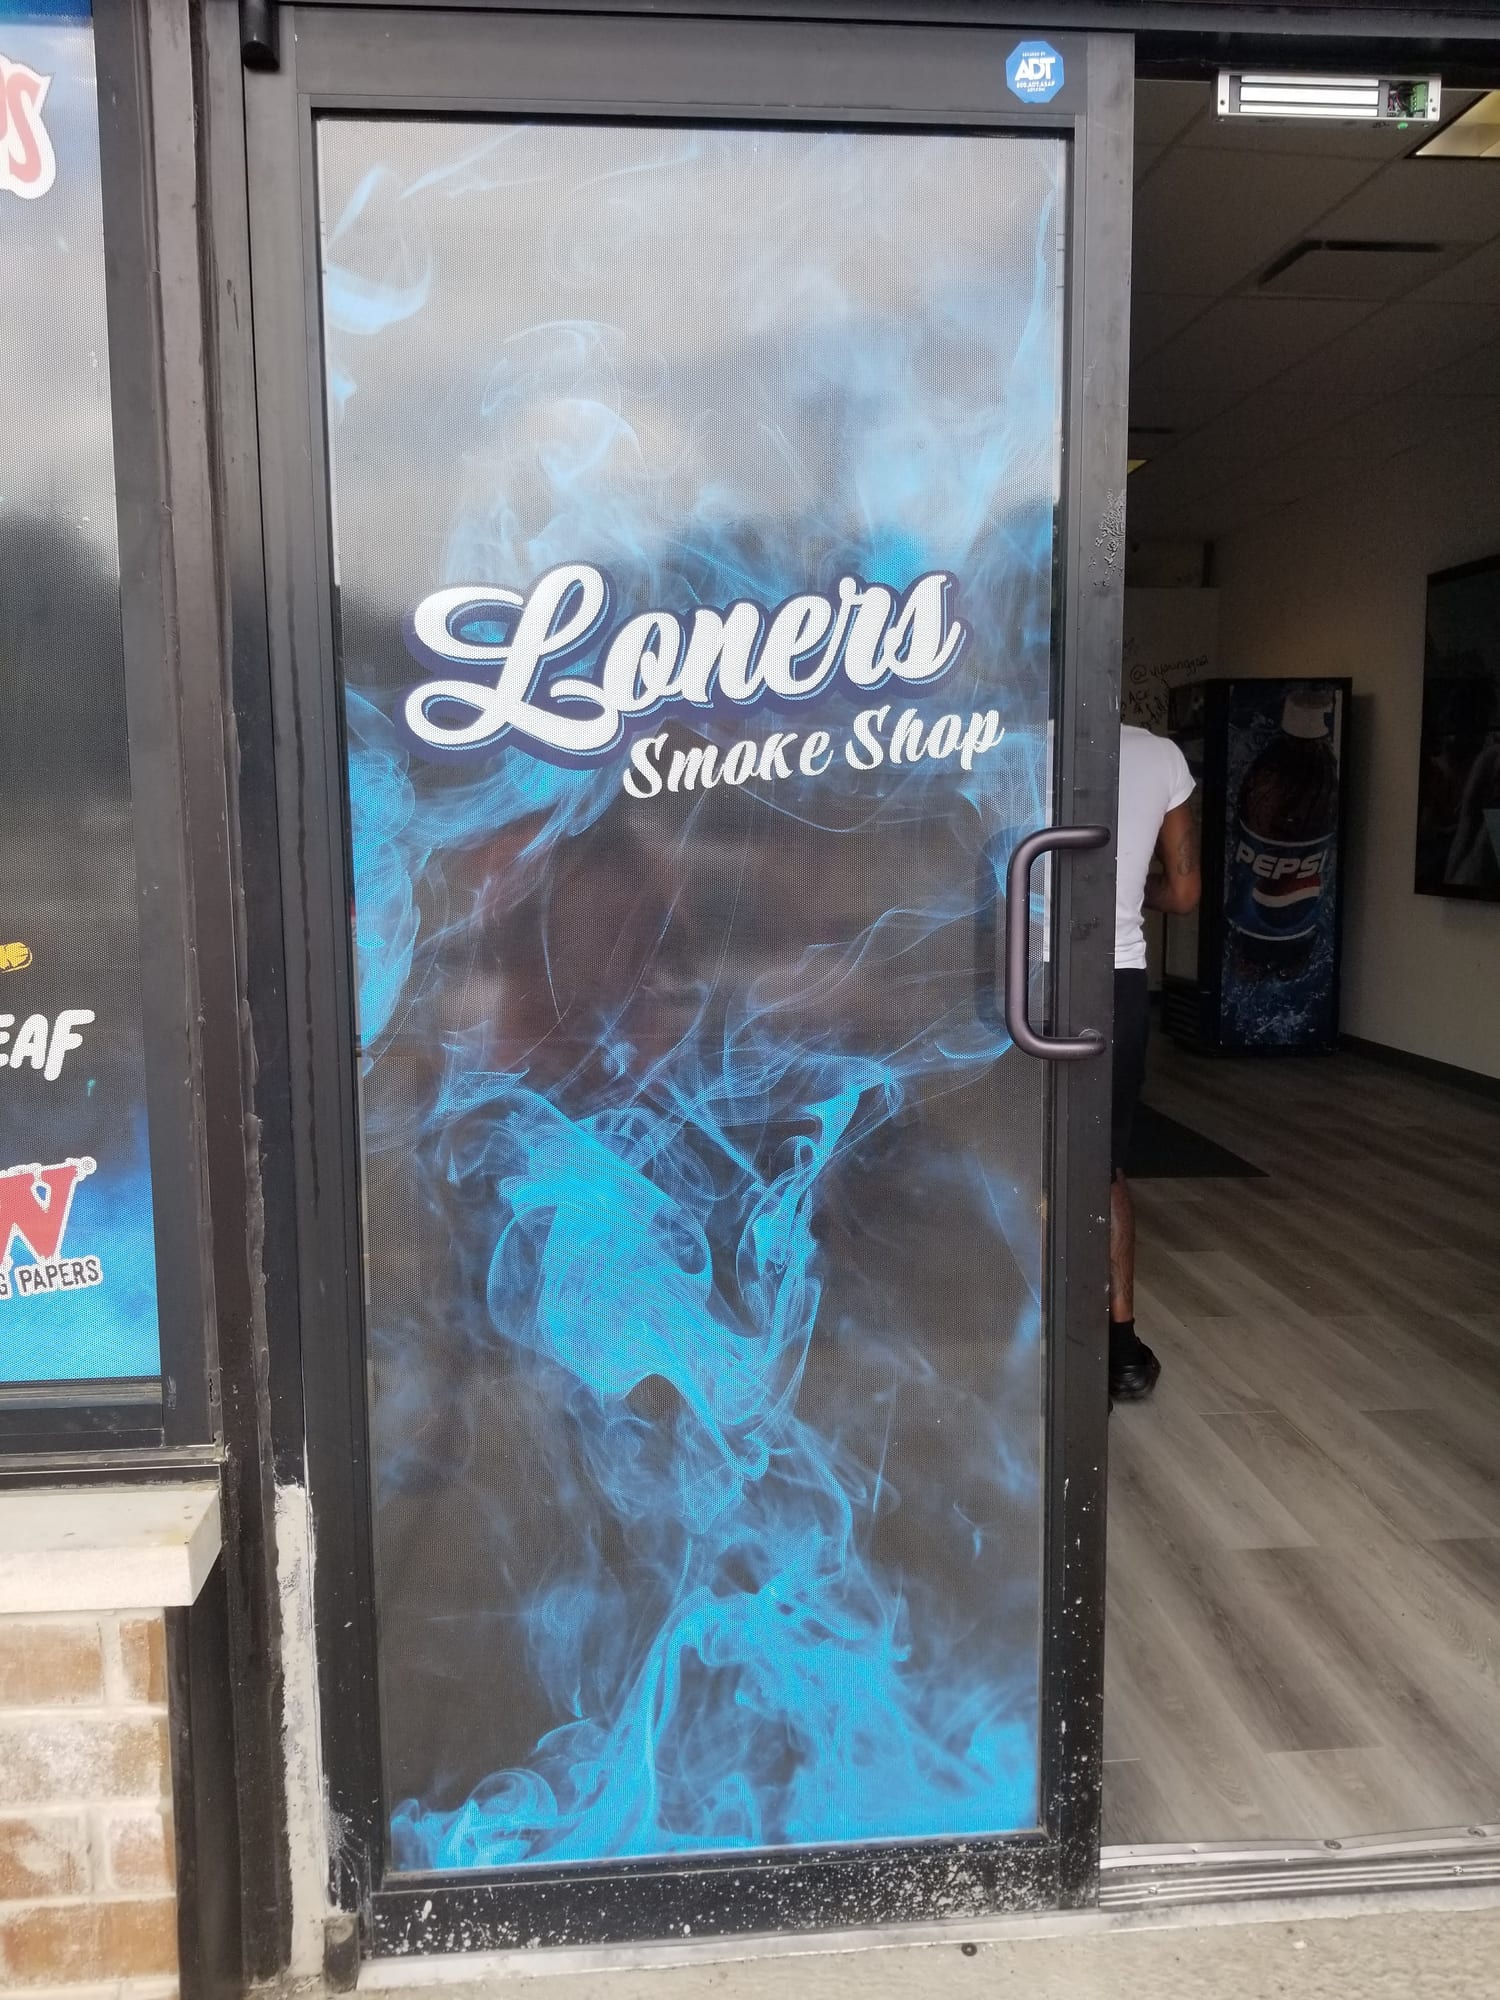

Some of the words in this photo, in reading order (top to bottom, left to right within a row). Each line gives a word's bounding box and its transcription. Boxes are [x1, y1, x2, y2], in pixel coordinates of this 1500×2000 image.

[1014, 56, 1057, 81] ADT
[0, 60, 49, 191] S
[404, 564, 966, 753] Loners
[621, 731, 836, 799] Smoke
[844, 704, 1006, 770] Shop
[1235, 840, 1328, 880] PEPSI
[18, 1258, 100, 1293] PAPERS
